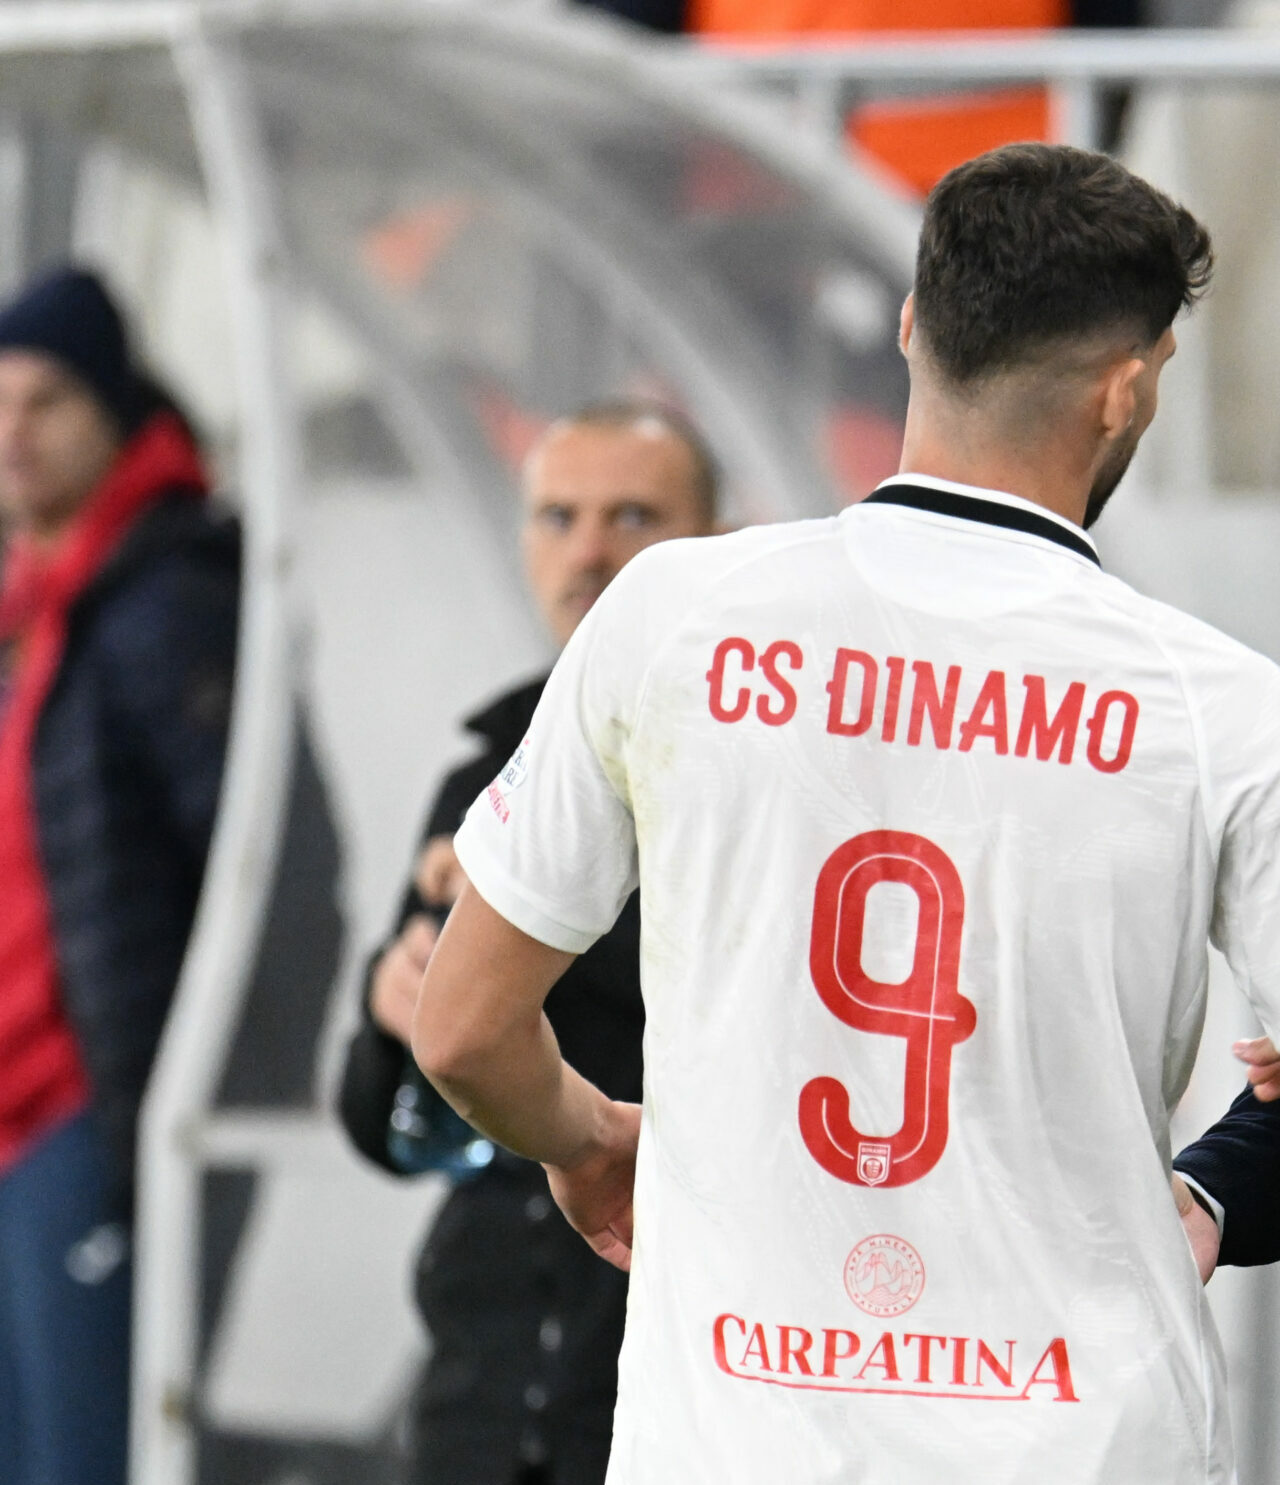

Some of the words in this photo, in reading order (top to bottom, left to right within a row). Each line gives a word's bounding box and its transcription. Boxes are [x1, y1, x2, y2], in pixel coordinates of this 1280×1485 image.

[706, 637, 803, 726] CS
[826, 648, 1139, 774] DINAMO
[798, 829, 977, 1188] 9
[713, 1313, 1080, 1402] CARPATINA
